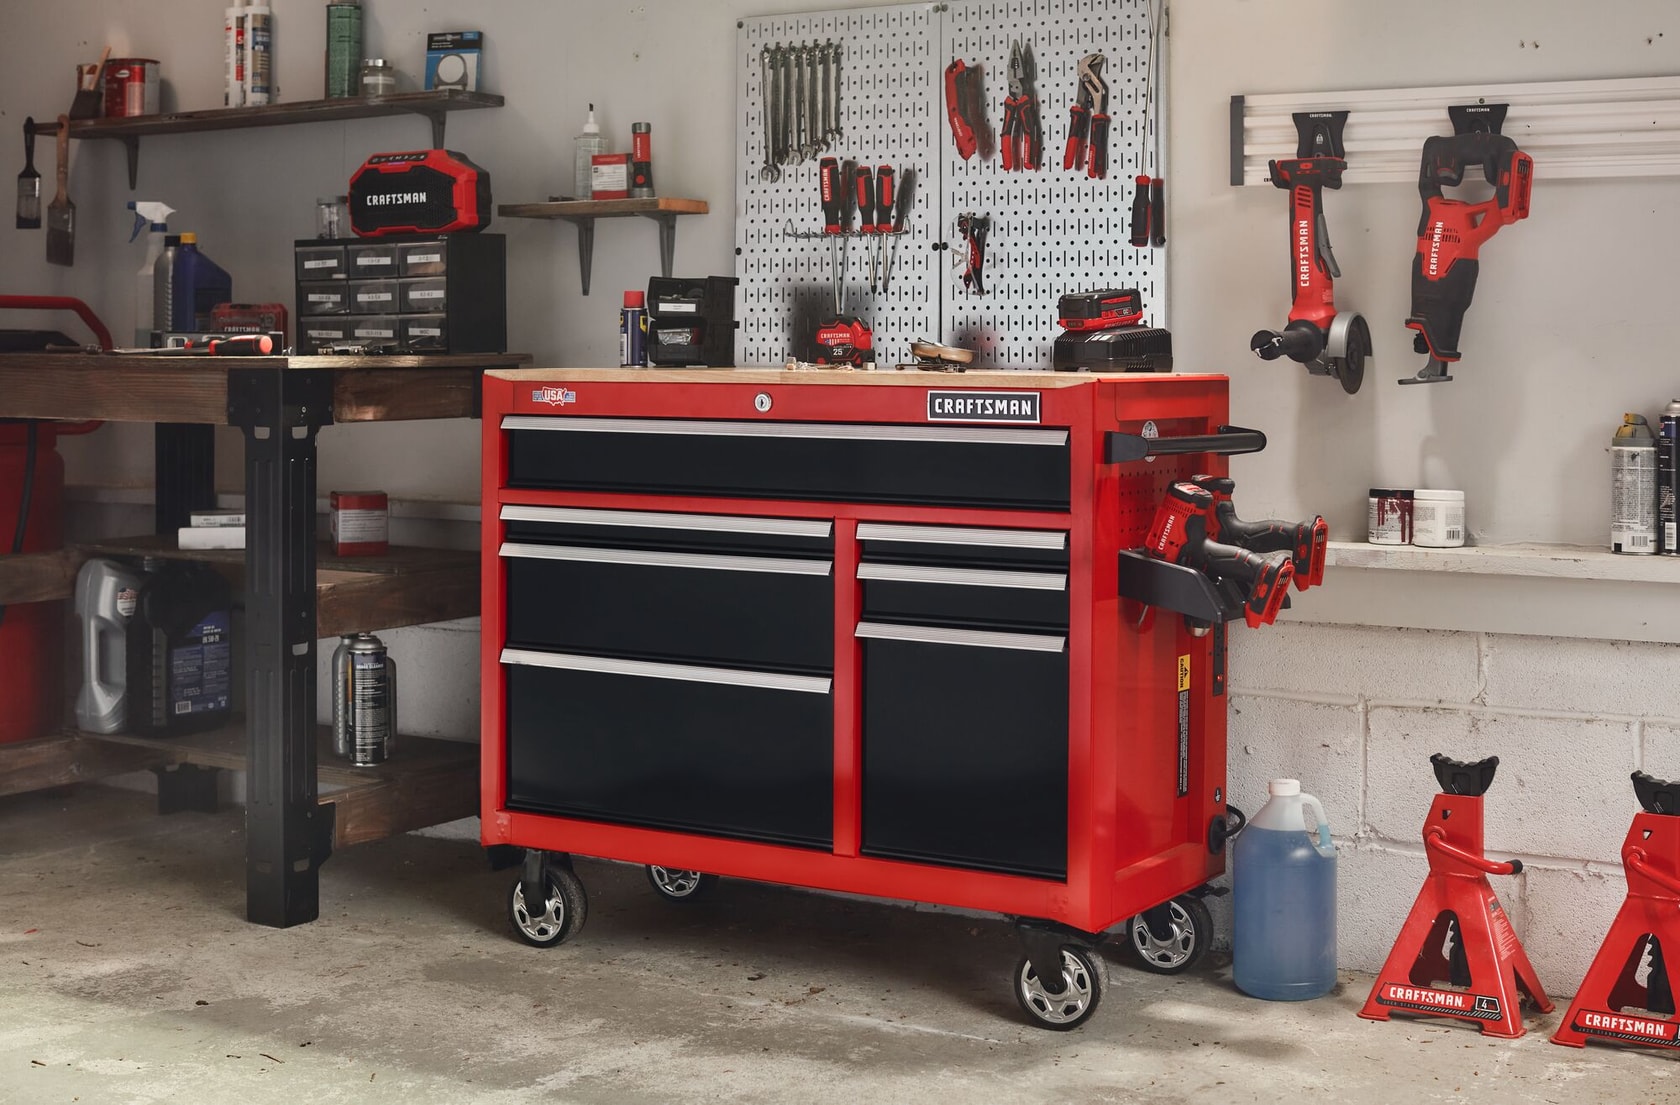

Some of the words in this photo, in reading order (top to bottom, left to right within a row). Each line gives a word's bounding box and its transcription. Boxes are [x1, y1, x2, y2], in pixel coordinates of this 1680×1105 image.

[822, 168, 831, 201] CRAFTSMAN
[366, 192, 427, 206] CRAFTSMAN
[1299, 220, 1310, 287] CRAFTSMAN
[1429, 221, 1444, 275] CRAFTSMAN
[833, 348, 843, 356] 25
[544, 390, 563, 401] USA
[934, 398, 1032, 415] CRAFTSMAN
[1158, 515, 1175, 550] CRAFTSMAN
[1389, 987, 1463, 1007] CRAFTSMAN
[1481, 999, 1488, 1009] 4
[1585, 1013, 1665, 1036] CRAFTSMAN
